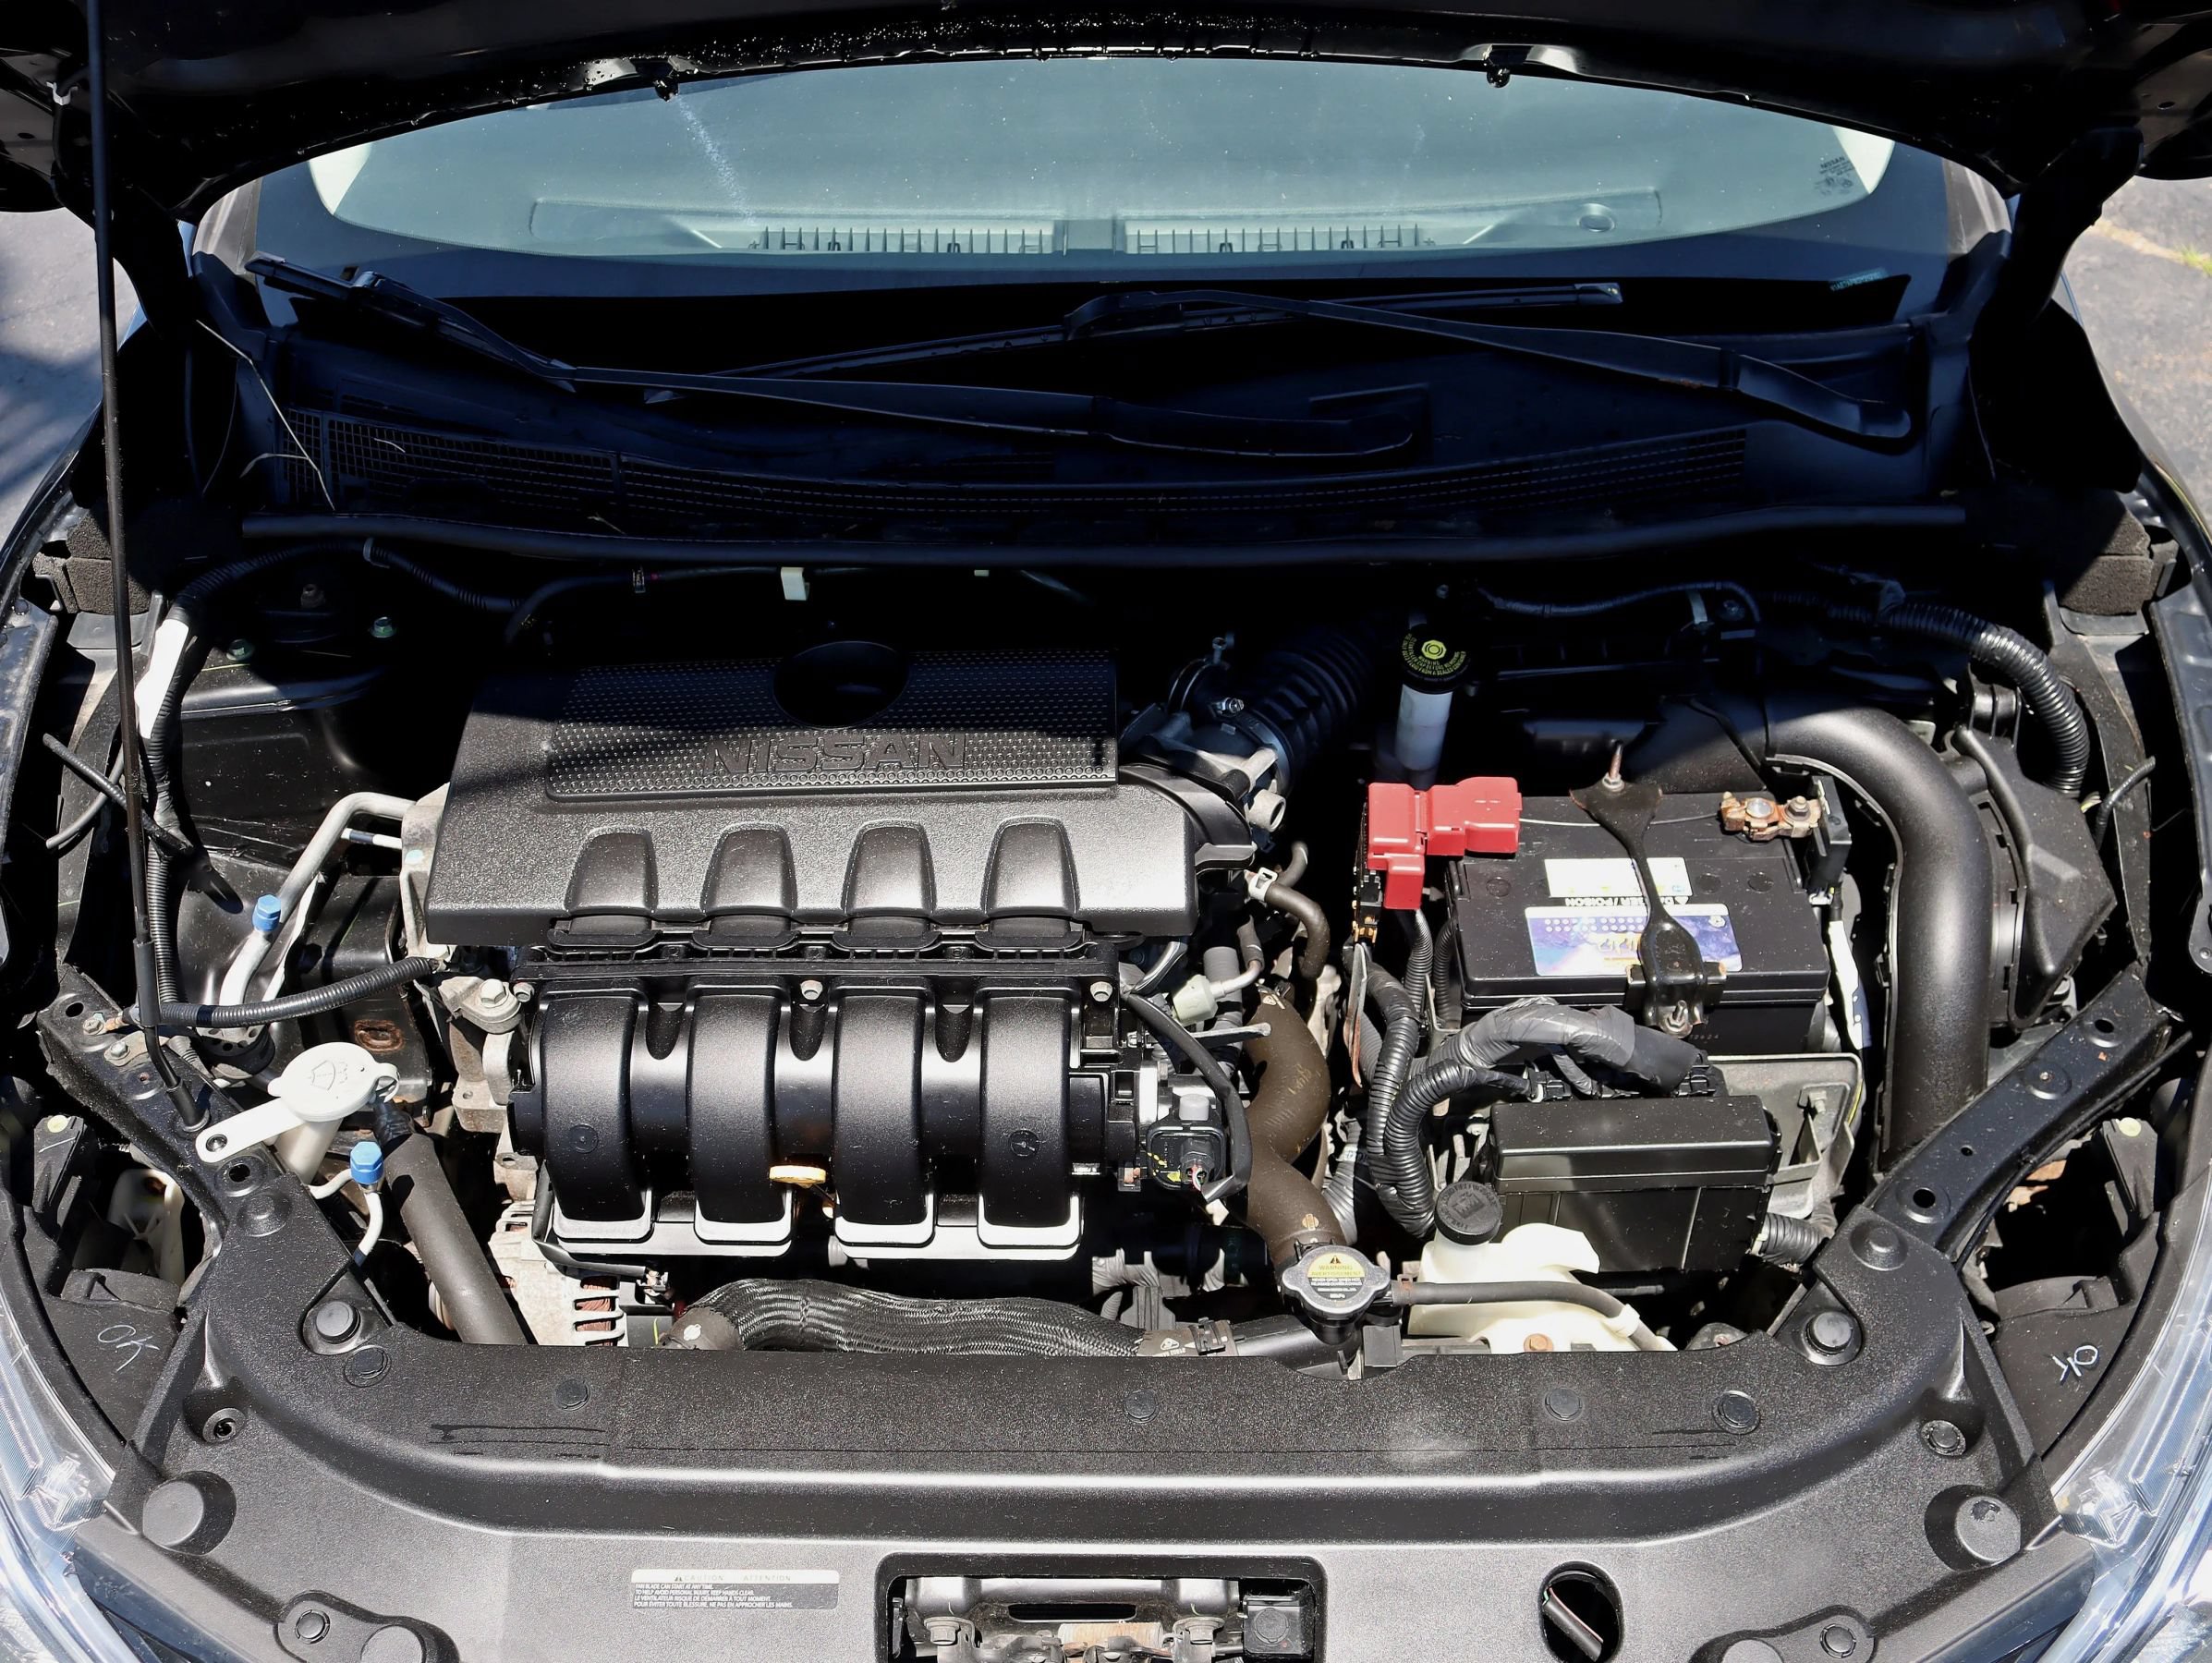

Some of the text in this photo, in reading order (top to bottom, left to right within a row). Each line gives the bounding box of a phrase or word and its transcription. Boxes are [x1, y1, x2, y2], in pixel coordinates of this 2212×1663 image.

[1820, 156, 1845, 168] NISSAN
[703, 731, 966, 774] NISSAN
[98, 1324, 160, 1372] OK
[2051, 1345, 2098, 1381] OK
